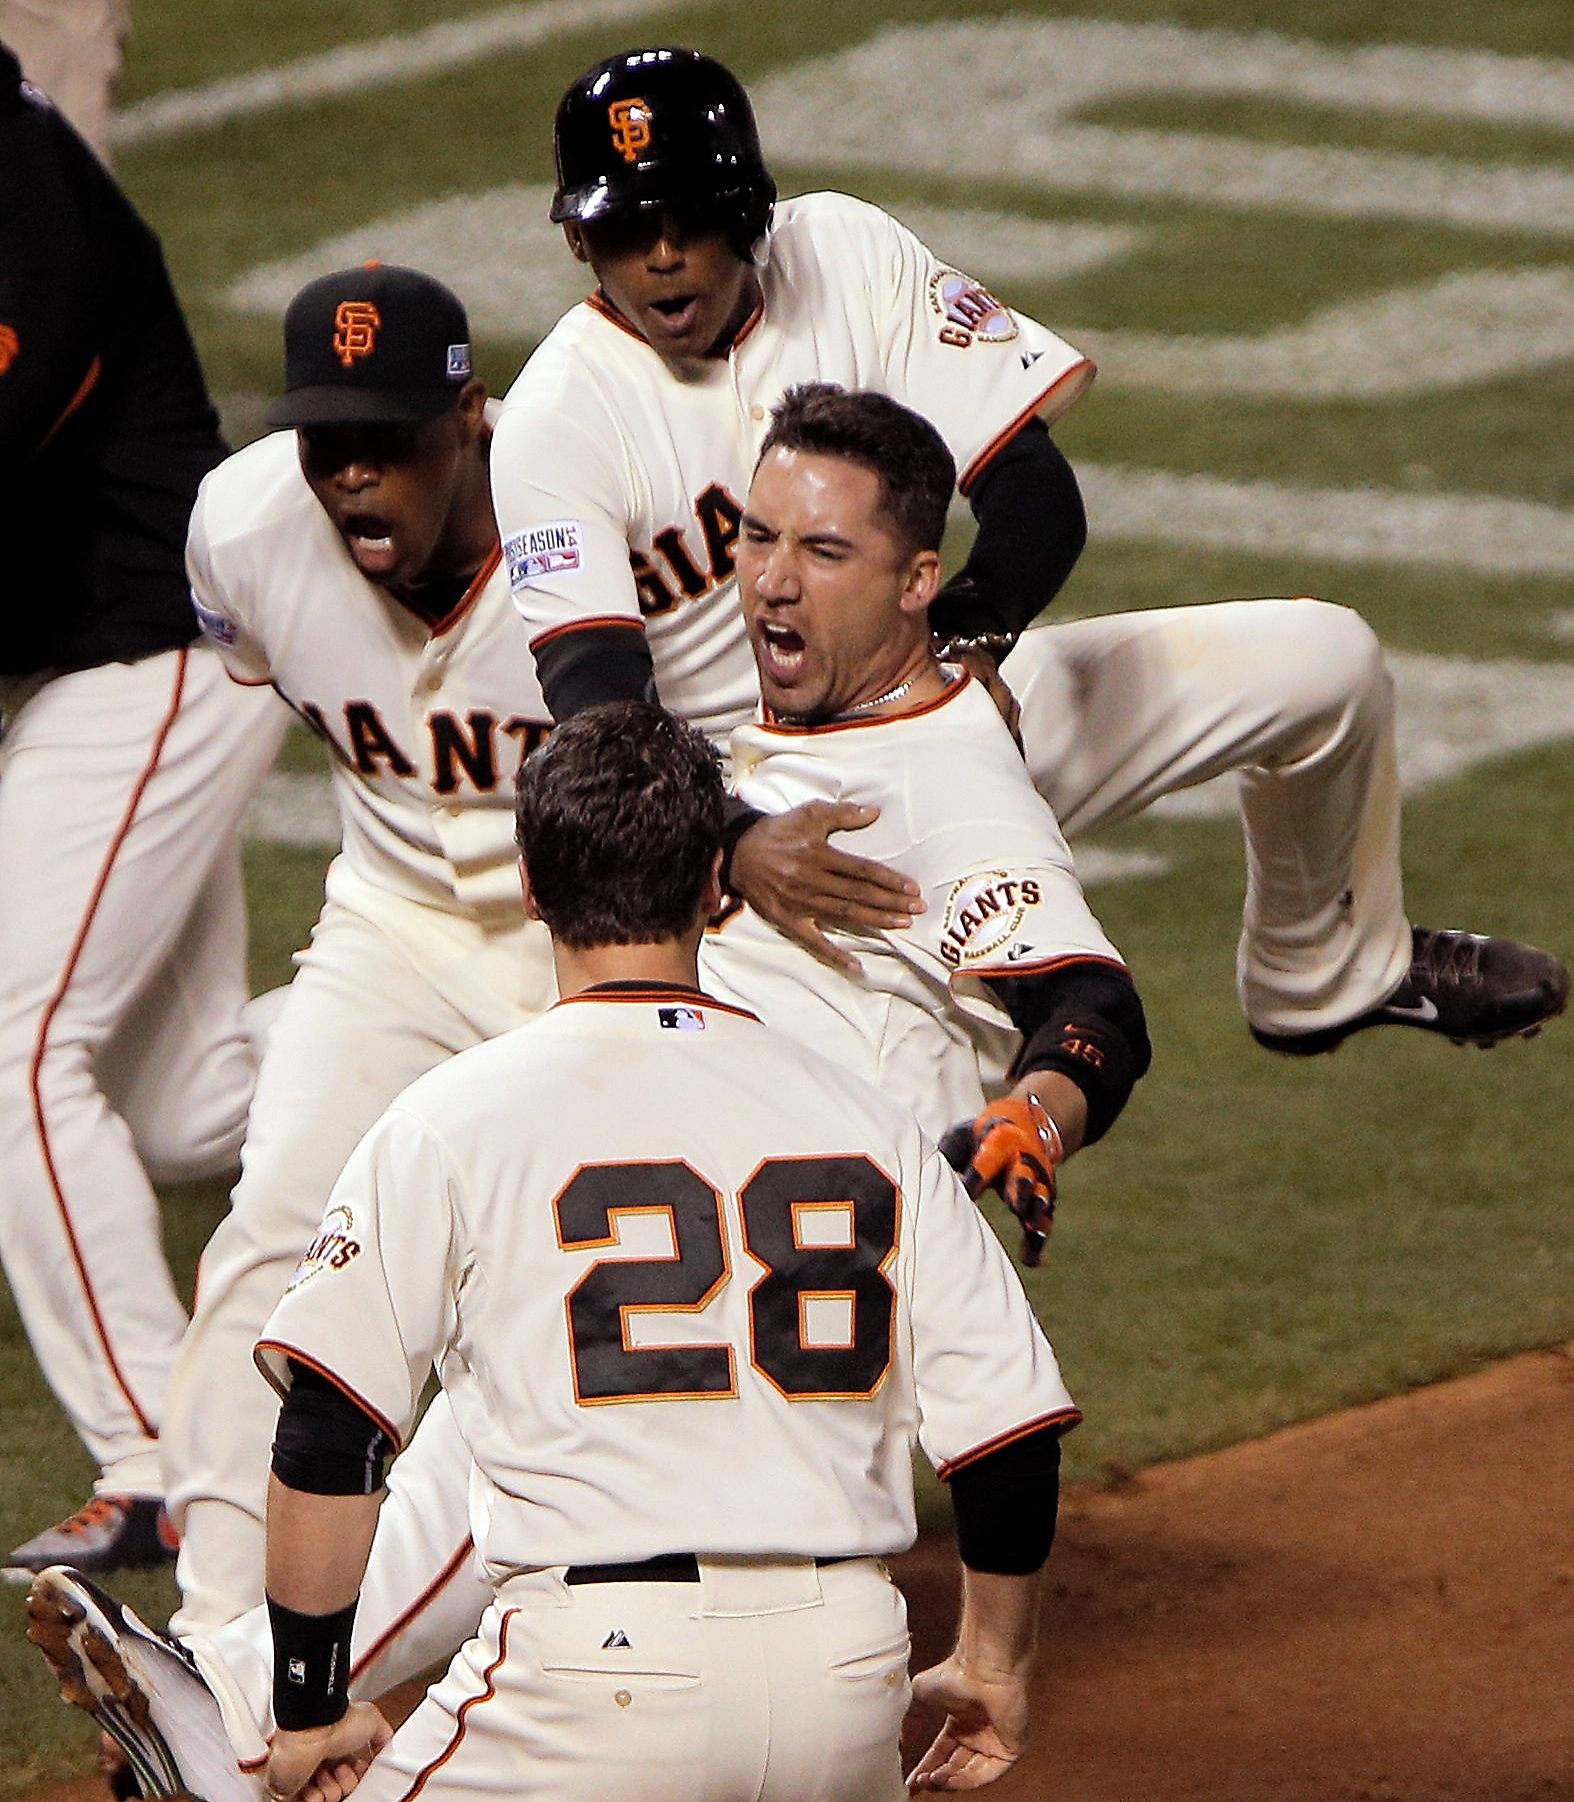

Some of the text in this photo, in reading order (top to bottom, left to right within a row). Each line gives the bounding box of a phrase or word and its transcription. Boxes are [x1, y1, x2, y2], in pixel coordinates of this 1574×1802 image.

[607, 97, 653, 163] SF
[333, 301, 382, 367] SF
[628, 482, 746, 618] GIA
[302, 697, 558, 797] ANT
[939, 879, 1042, 967] GIANTS
[1061, 1038, 1105, 1068] 45
[551, 1151, 904, 1408] 28
